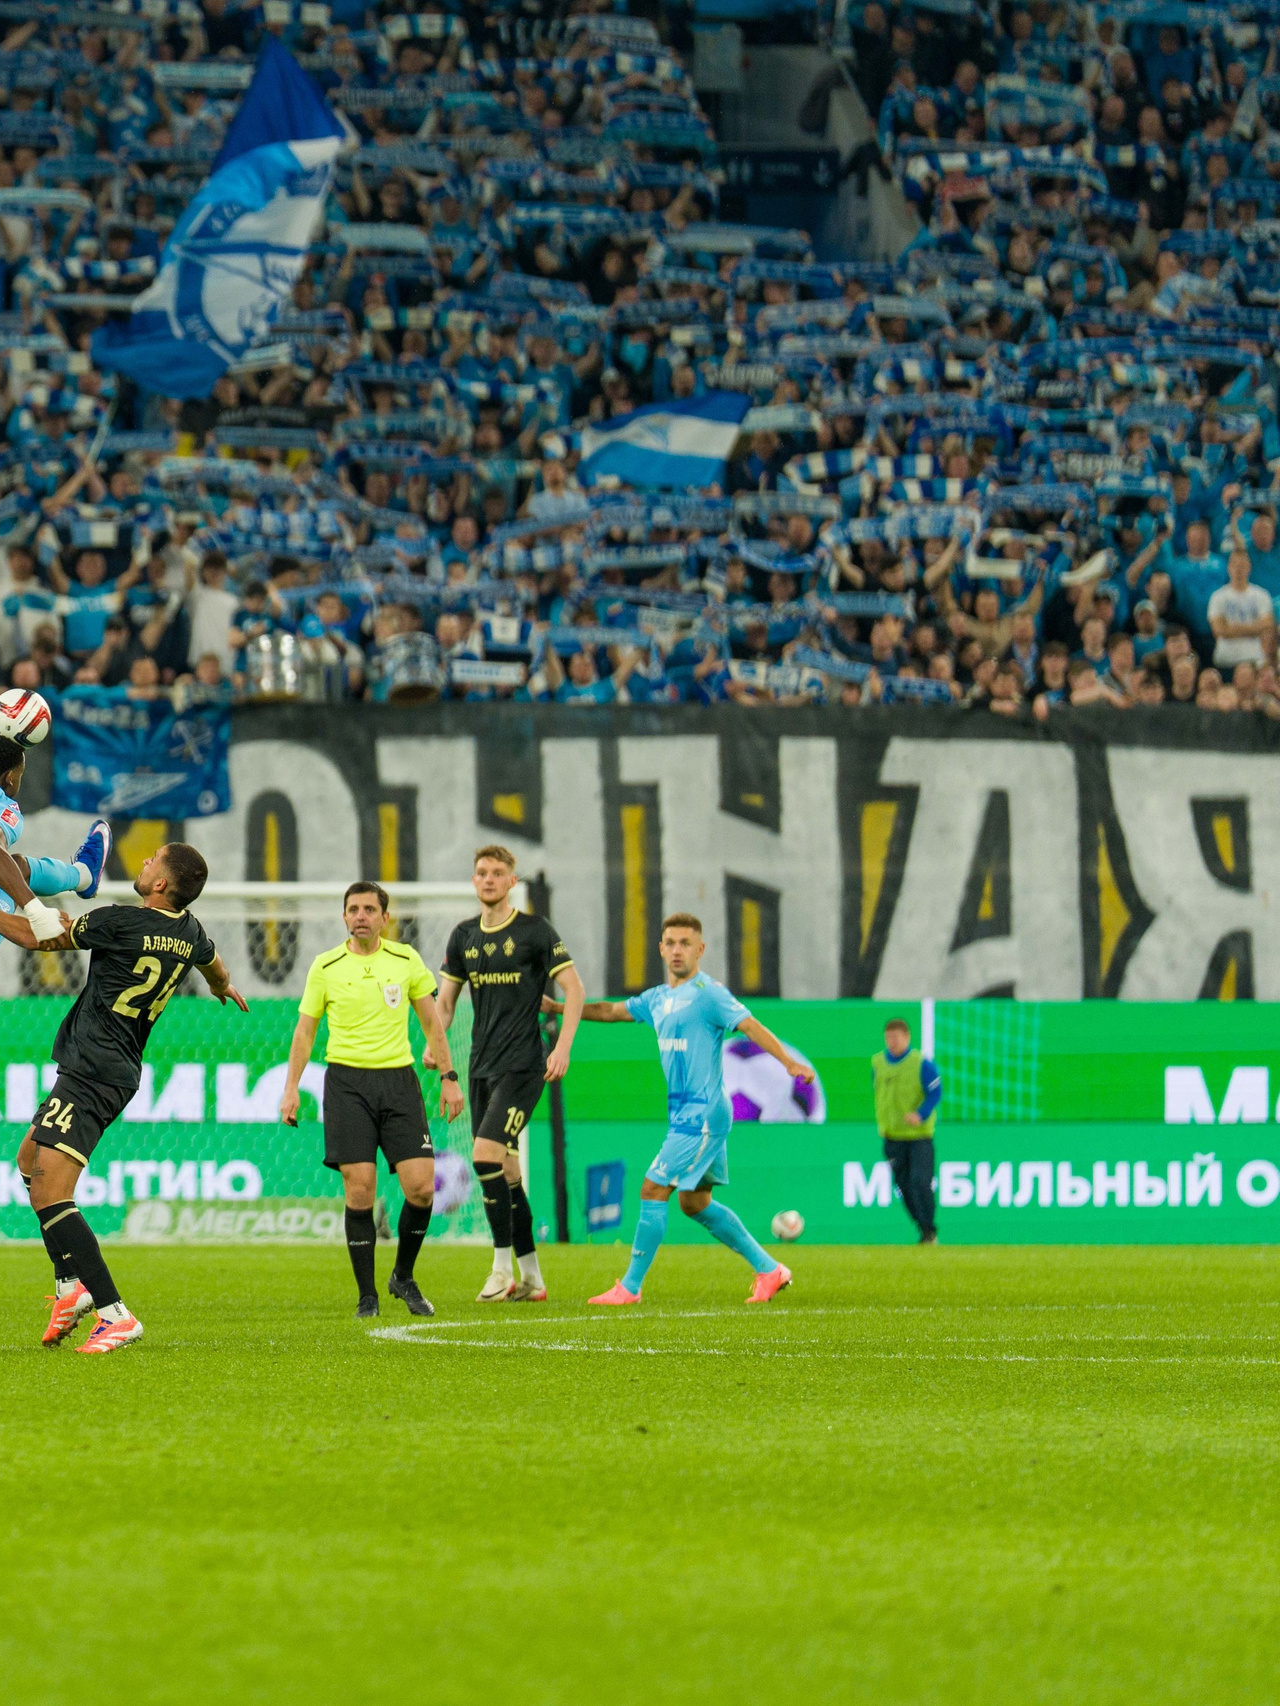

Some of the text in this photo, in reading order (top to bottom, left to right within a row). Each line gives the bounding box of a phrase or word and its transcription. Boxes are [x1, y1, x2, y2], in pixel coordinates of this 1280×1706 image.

[142, 935, 194, 960] АЛАРКОН
[111, 955, 186, 1022] 24
[478, 971, 522, 986] МАГНИТ
[1165, 1066, 1280, 1124] М
[40, 1097, 75, 1134] 24
[503, 1105, 526, 1137] 19
[842, 1151, 1223, 1208] МБИЛЬНЫЙ
[175, 1206, 342, 1237] МЕГАФО
